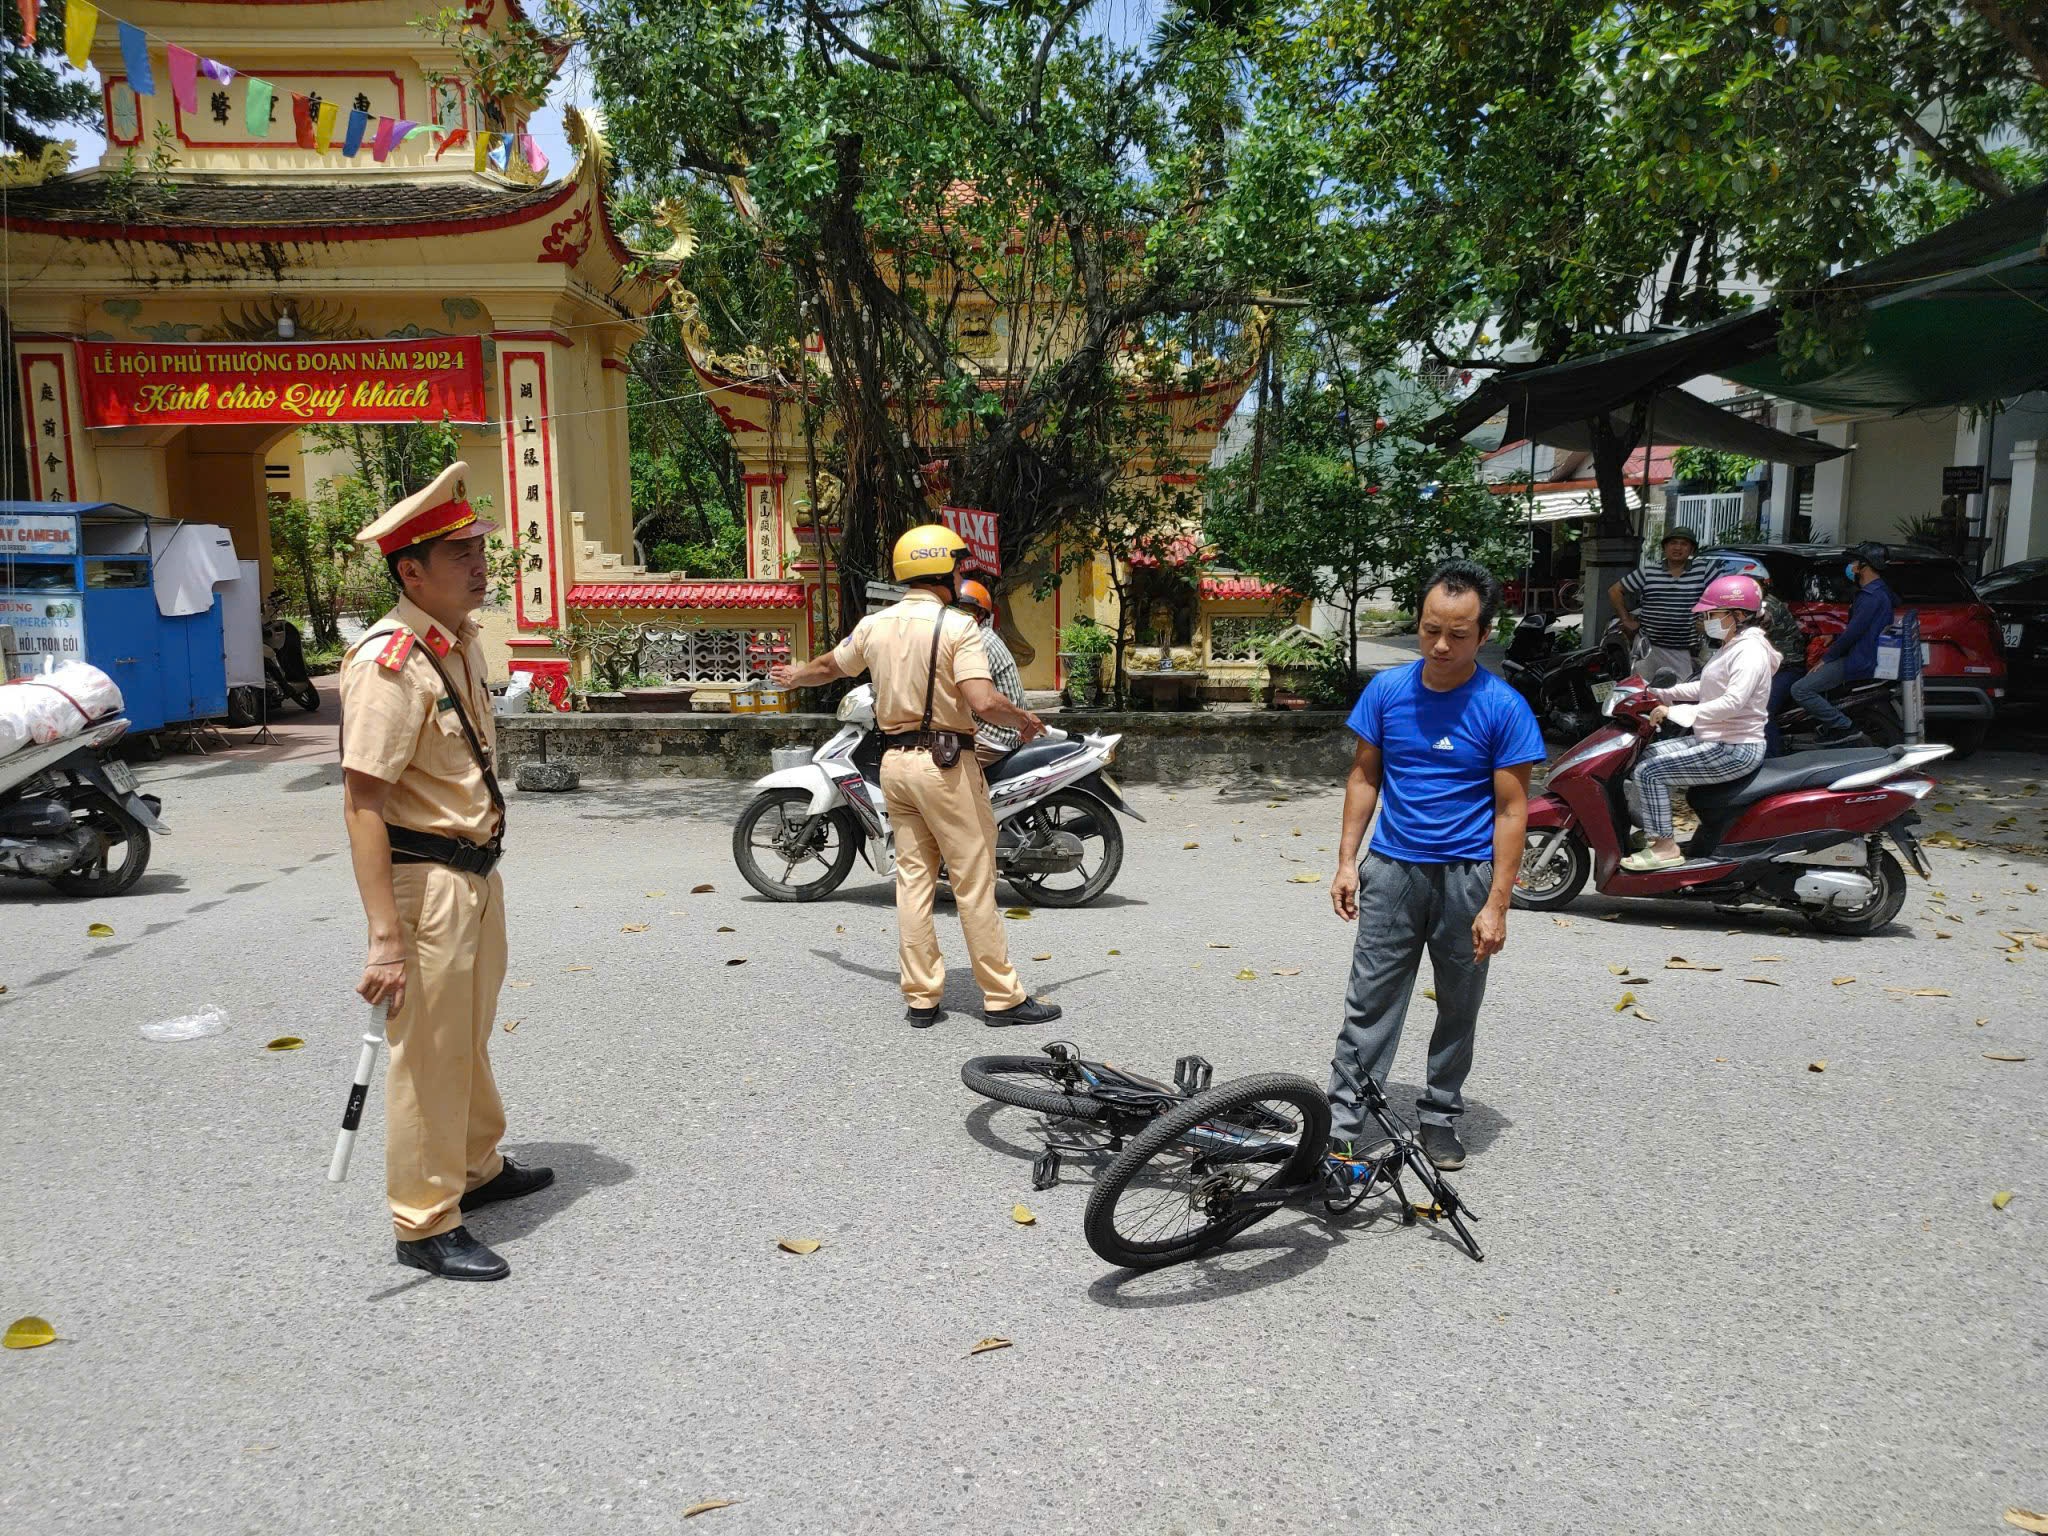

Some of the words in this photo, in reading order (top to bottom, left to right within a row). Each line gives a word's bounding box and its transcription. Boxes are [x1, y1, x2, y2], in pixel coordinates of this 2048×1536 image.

[94, 349, 115, 374] LỄ
[120, 351, 157, 377] HỘI
[162, 349, 201, 373] PHỦ
[206, 351, 292, 377] THƯỢNG
[296, 353, 356, 375] ĐOẠN
[362, 348, 408, 370] NĂM
[412, 351, 465, 370] 2024
[134, 382, 209, 413] Kính
[217, 382, 278, 410] chào
[280, 383, 347, 417] Quý
[351, 380, 430, 408] khách
[18, 528, 70, 543] CAMERA
[944, 509, 995, 546] TAXI
[911, 547, 948, 560] CSGT
